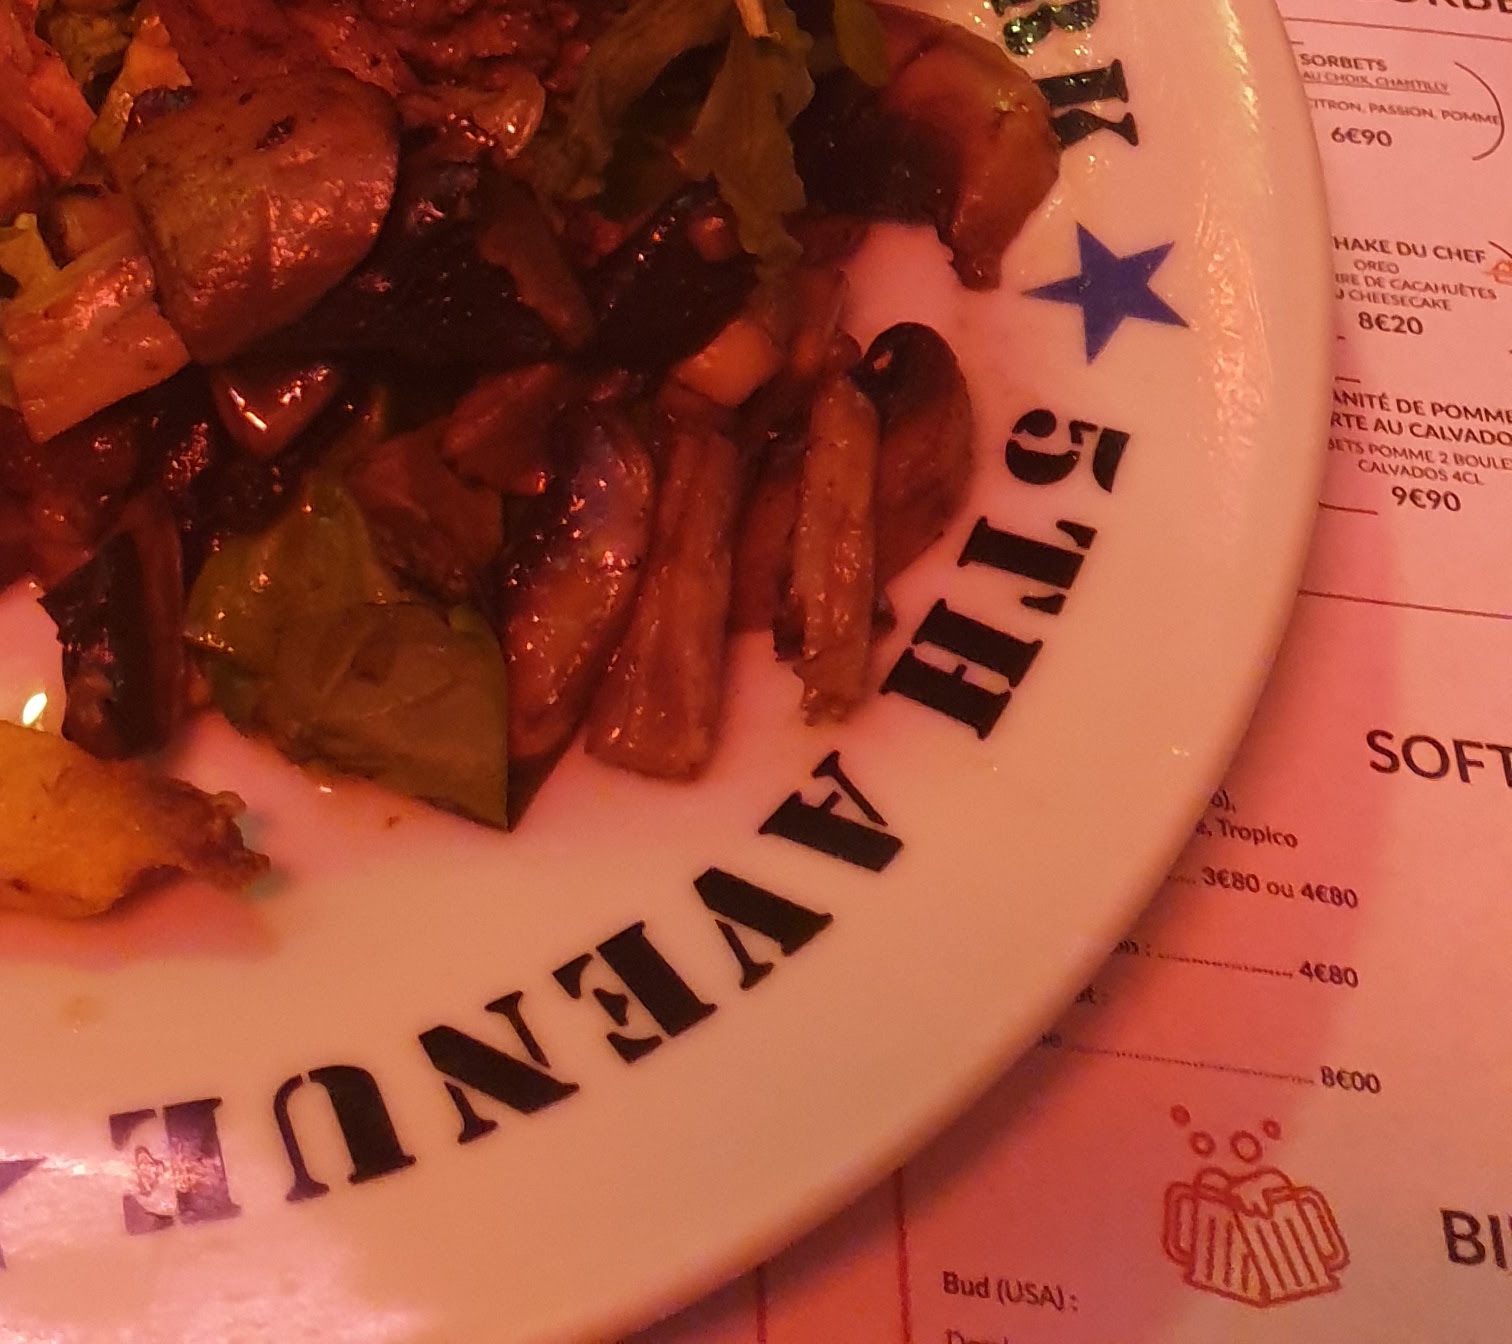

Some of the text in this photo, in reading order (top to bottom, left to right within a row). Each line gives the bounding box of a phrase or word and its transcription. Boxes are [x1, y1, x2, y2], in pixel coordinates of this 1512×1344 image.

[1298, 52, 1388, 73] SORBETS
[1330, 126, 1394, 148] 6€90
[1332, 235, 1487, 264] HAKE DU CHEF
[1353, 258, 1401, 276] OREO
[1357, 310, 1425, 336] 8€20
[1395, 397, 1427, 417] DE
[1373, 417, 1405, 436] AU
[1368, 442, 1435, 463] POMME
[1438, 449, 1450, 465] 2
[1357, 458, 1450, 483] CALVADOS
[1390, 485, 1463, 513] 9€90
[879, 406, 1132, 741] 5TH
[1215, 816, 1300, 850] Tropico
[1200, 864, 1360, 910] 3€80 ou 4€80
[1298, 959, 1360, 989] 4€80
[109, 749, 905, 1235] AVENUE
[1318, 1064, 1382, 1095] 8€00
[940, 1269, 990, 1299] Bud
